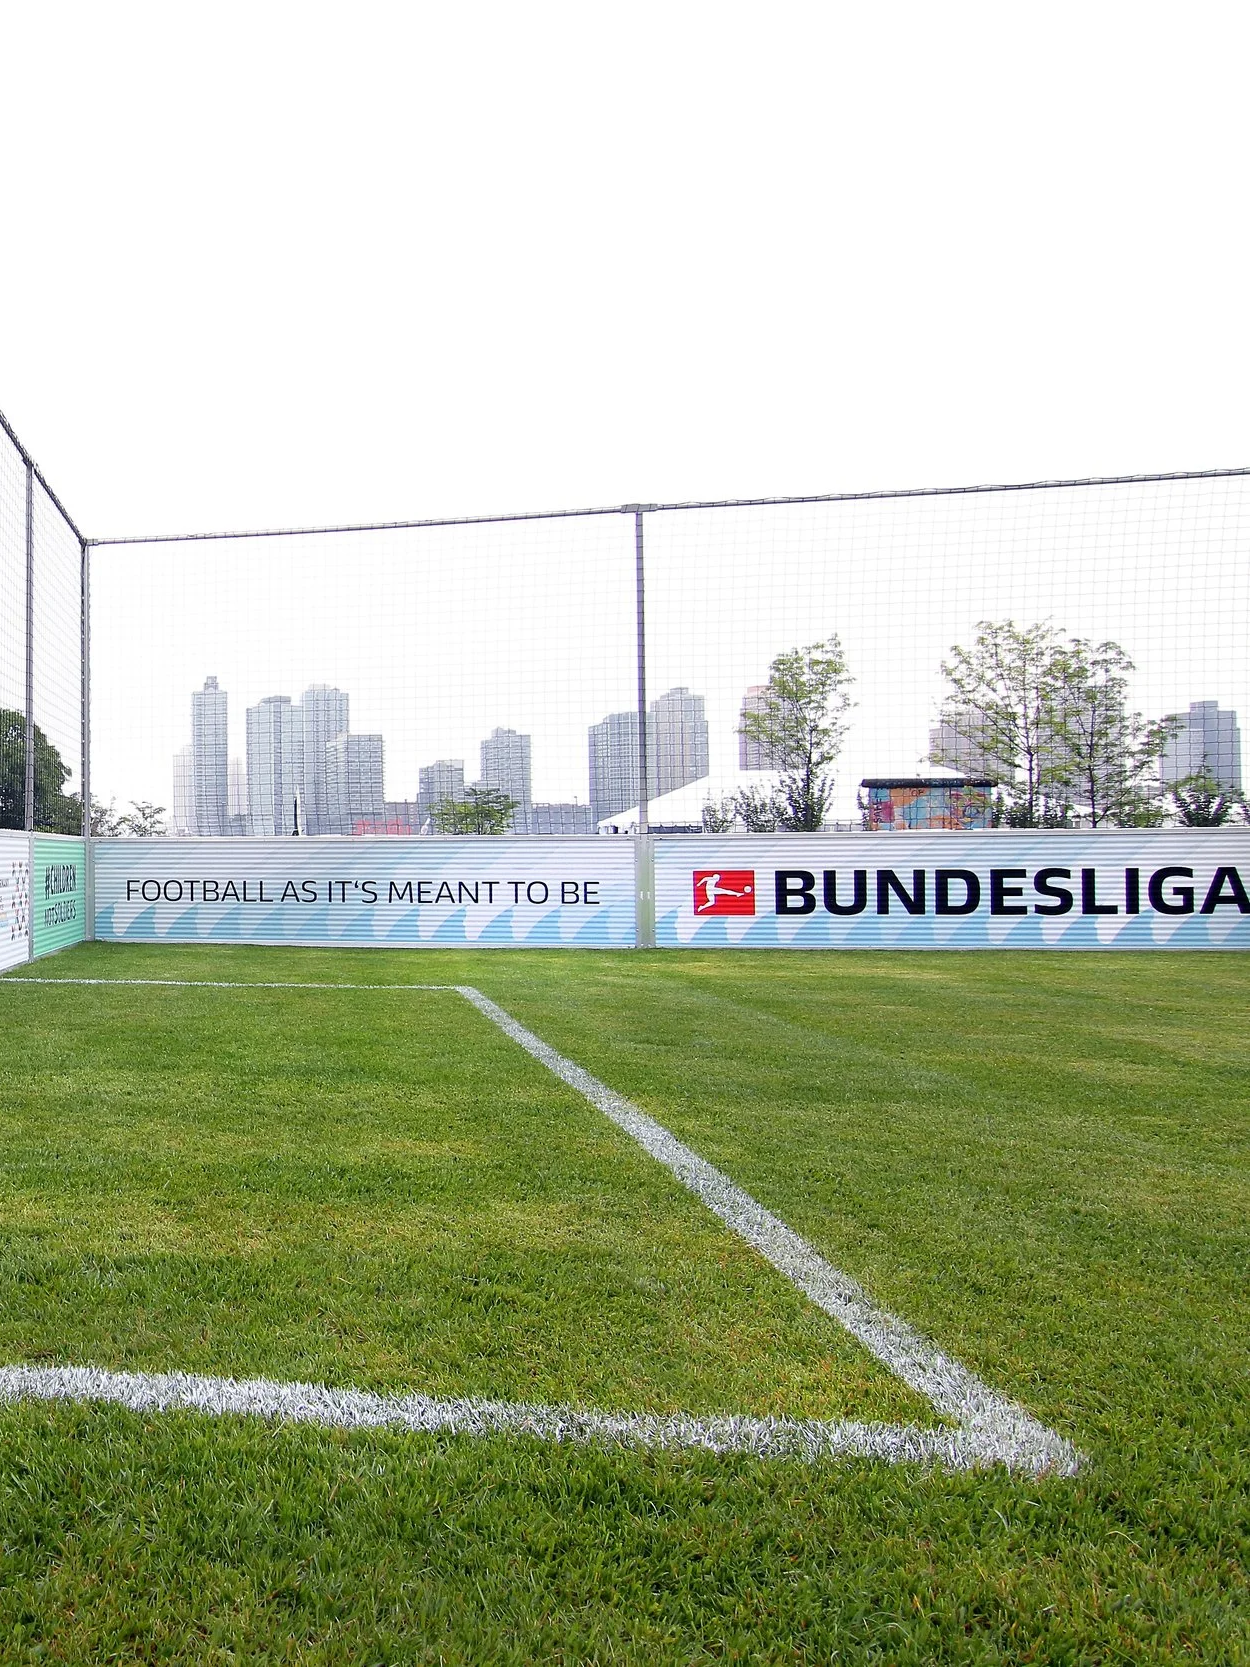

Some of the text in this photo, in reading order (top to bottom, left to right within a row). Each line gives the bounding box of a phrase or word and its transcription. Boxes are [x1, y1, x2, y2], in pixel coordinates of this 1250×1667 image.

[45, 864, 77, 900] #CHILDREN
[125, 879, 600, 905] FOOTBALL AS IT'S MEANT TO BE
[774, 866, 1250, 916] BUNDESLIGA
